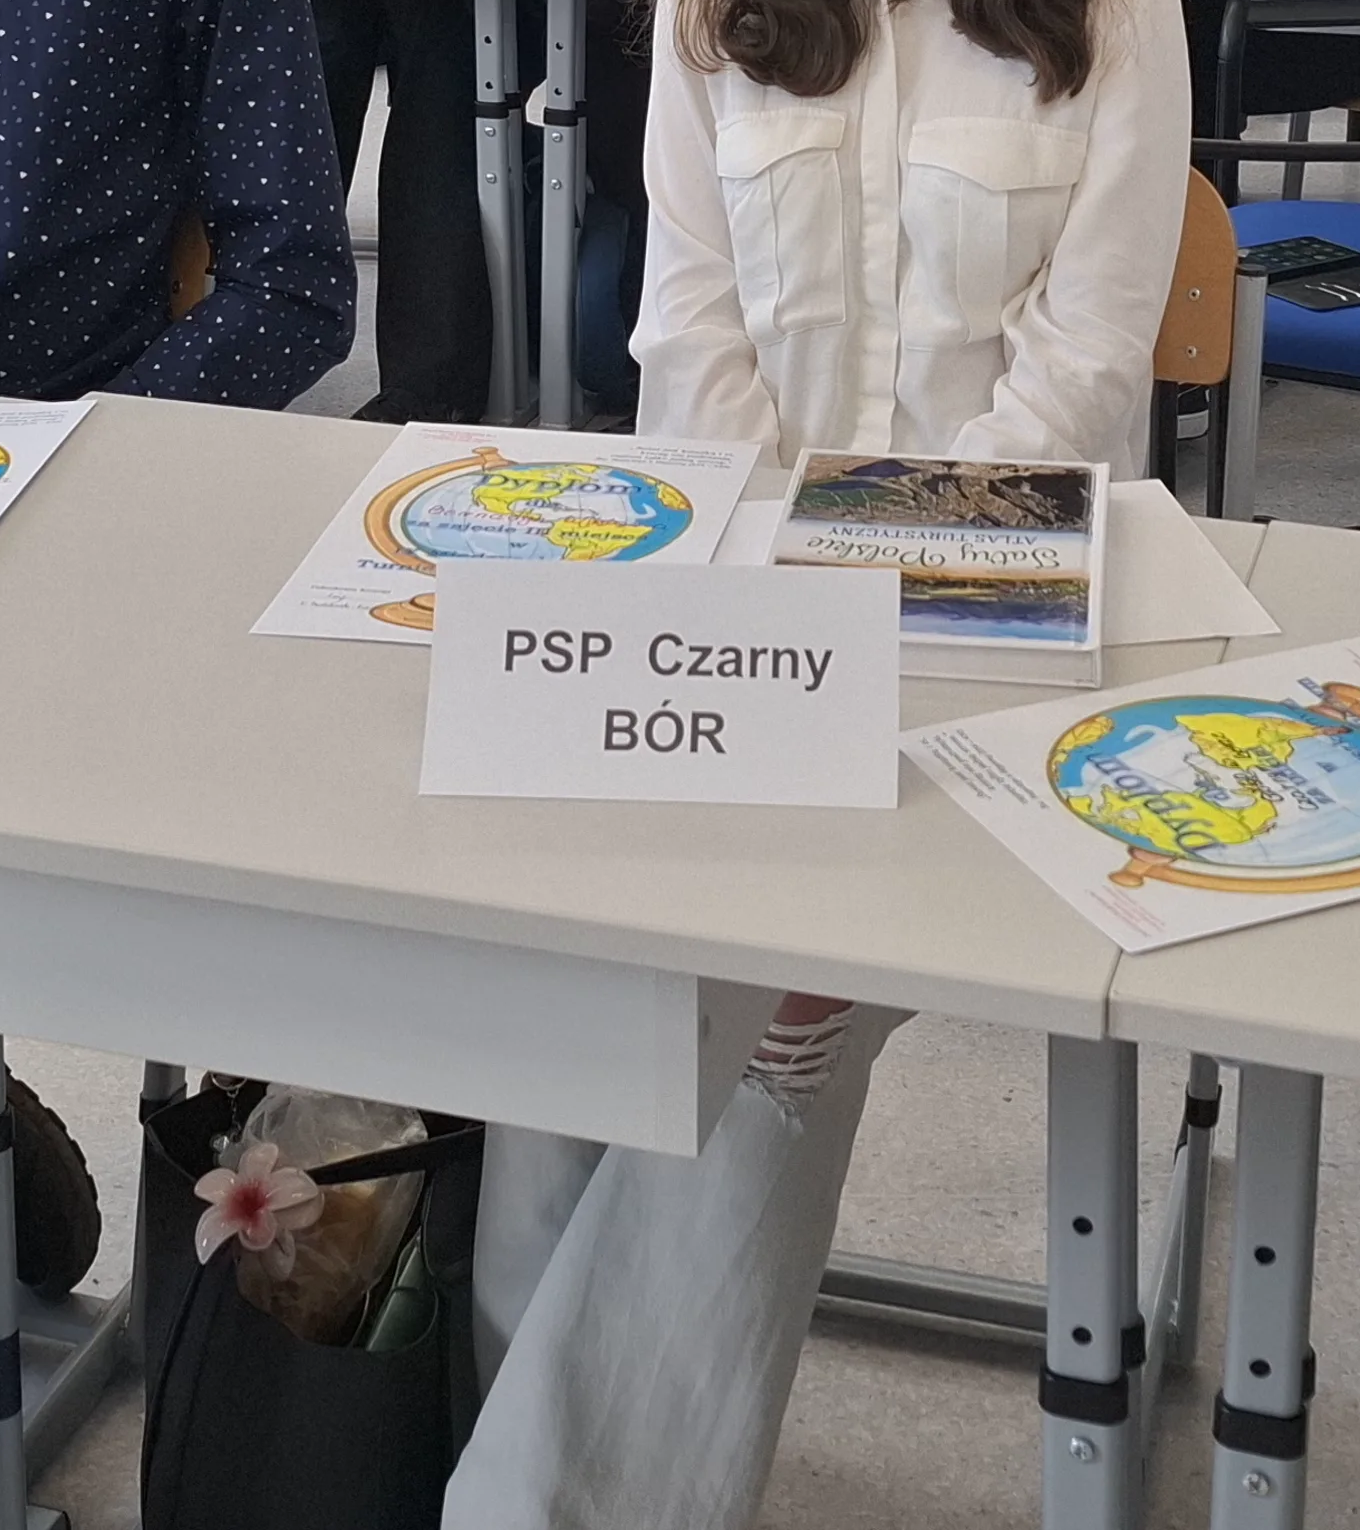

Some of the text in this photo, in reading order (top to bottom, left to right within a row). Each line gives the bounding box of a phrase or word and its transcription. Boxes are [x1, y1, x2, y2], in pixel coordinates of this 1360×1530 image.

[478, 473, 643, 496] Dyplom
[806, 535, 1061, 569] Tatry Polskie
[828, 525, 1039, 546] ATLAS TURYSTYCZNY
[503, 629, 834, 692] PSP Czarny
[603, 699, 727, 754] BÓR
